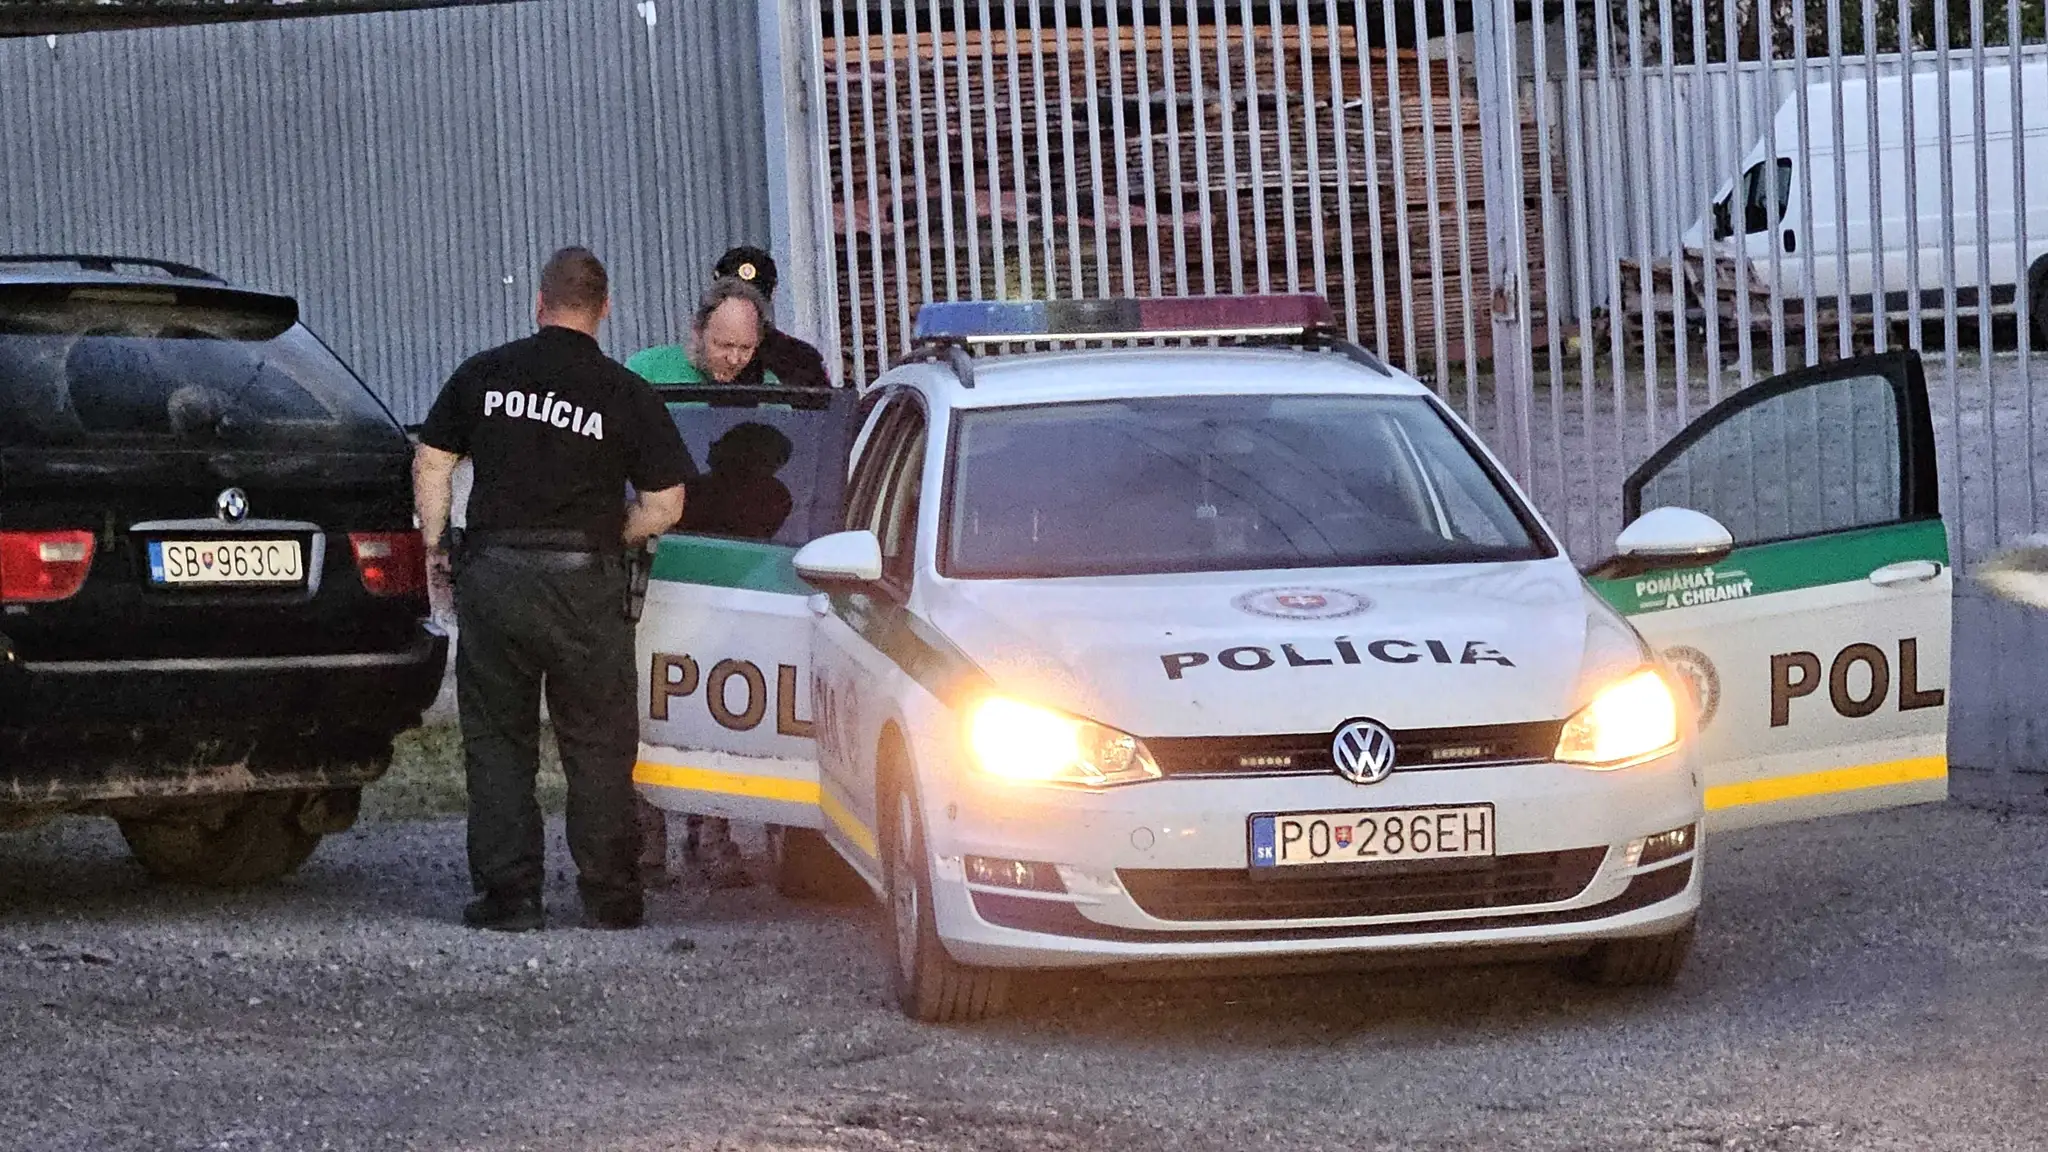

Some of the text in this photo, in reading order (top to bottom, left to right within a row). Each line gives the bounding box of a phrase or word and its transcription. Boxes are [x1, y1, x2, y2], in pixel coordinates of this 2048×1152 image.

[484, 391, 603, 440] POLÍCIA
[1666, 593, 1680, 609] A
[1160, 635, 1516, 680] POLÍCIA
[650, 652, 817, 739] POL
[1770, 637, 1945, 728] POL
[1257, 847, 1273, 859] SK
